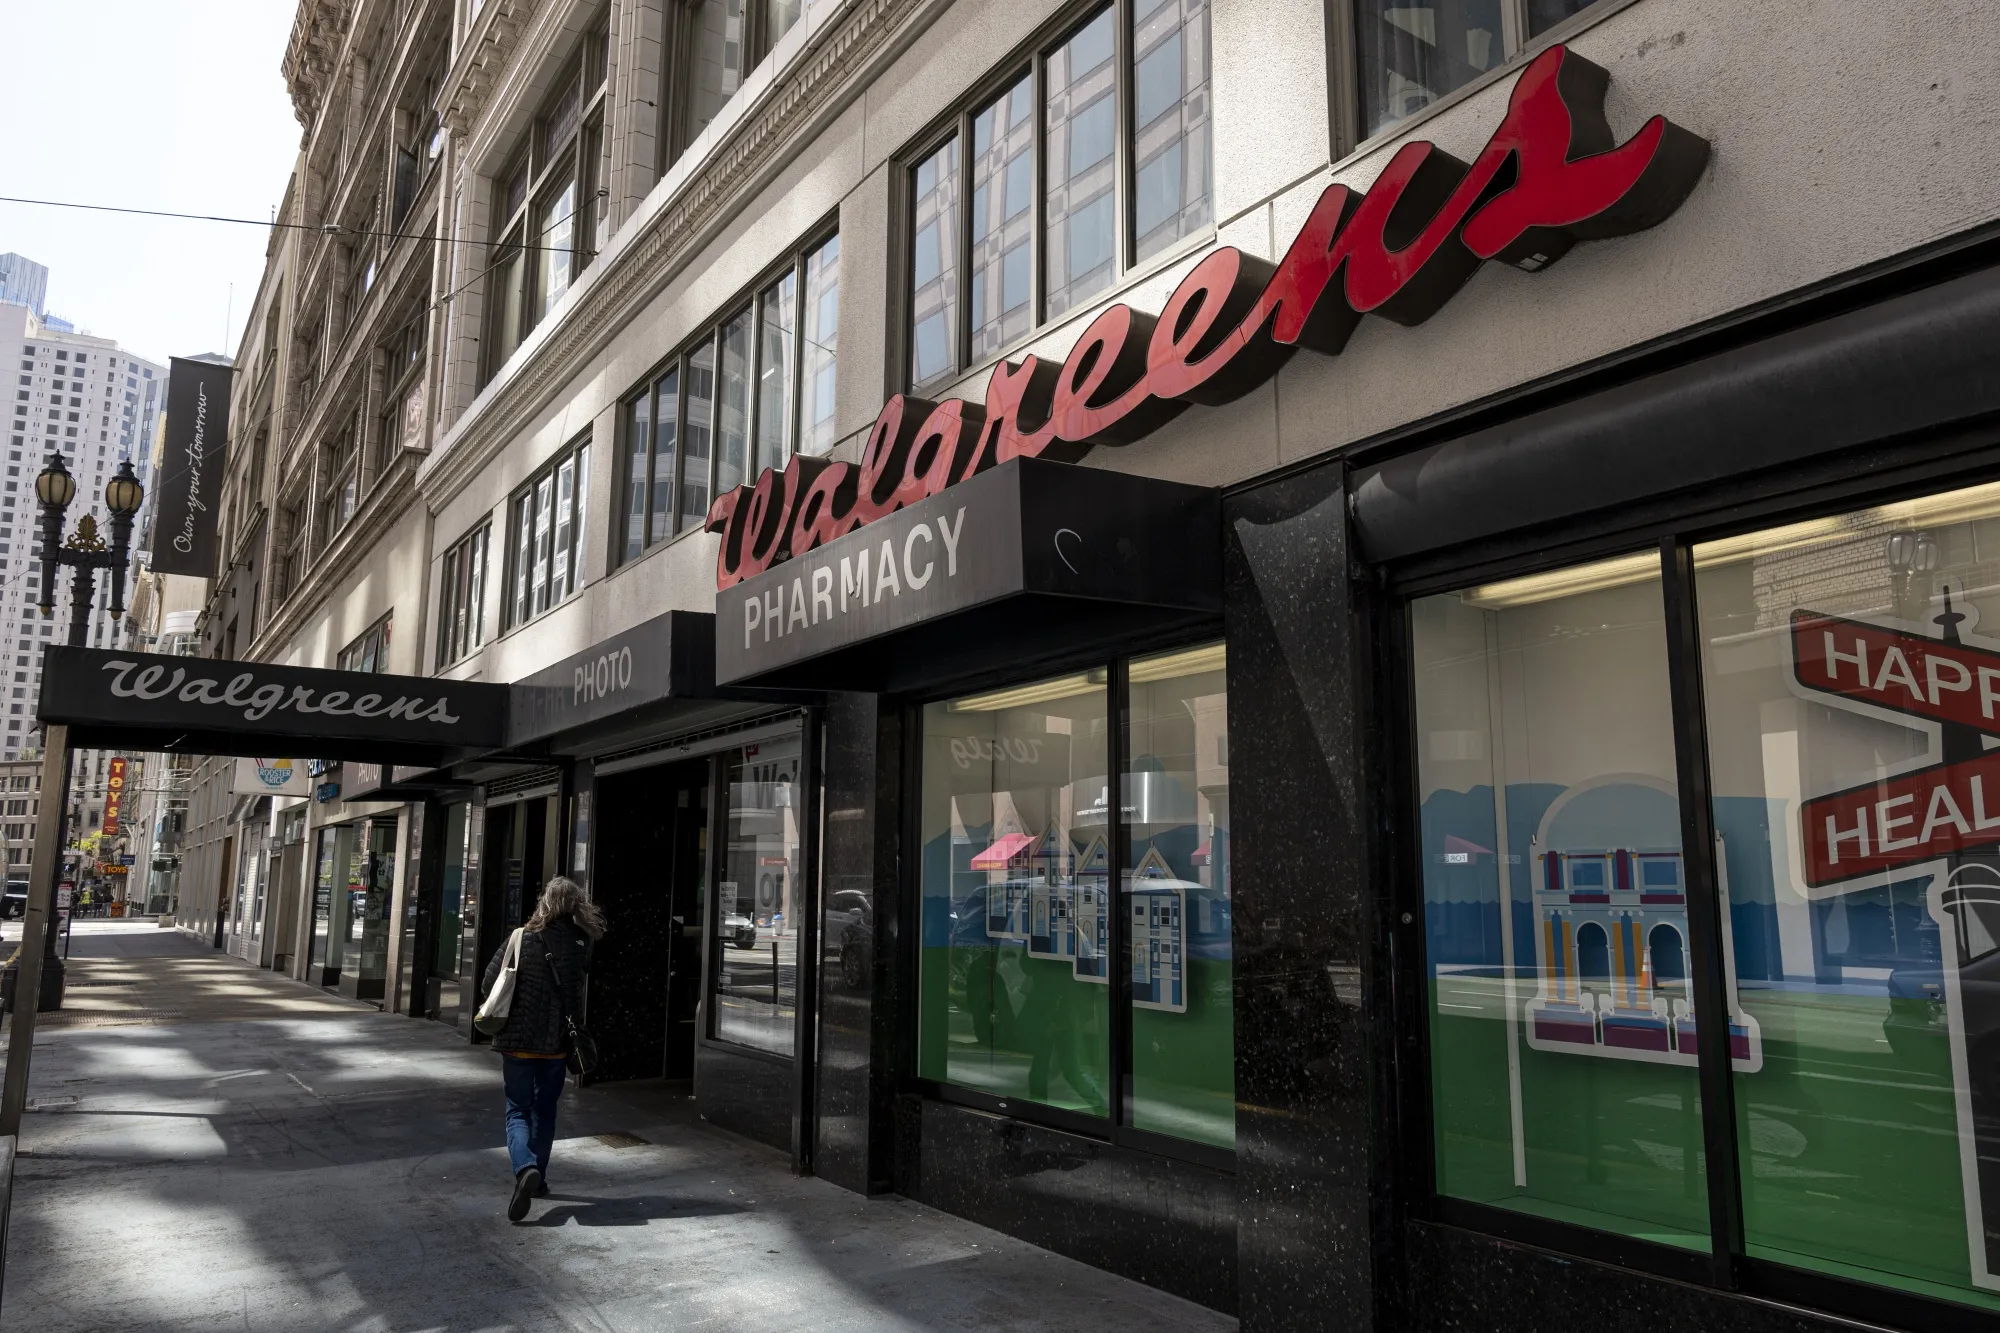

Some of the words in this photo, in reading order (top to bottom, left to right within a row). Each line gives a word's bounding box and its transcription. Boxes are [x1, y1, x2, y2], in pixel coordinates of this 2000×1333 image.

[704, 43, 1667, 592] Walgreens
[185, 382, 207, 467] tomorrow
[187, 467, 206, 511] your
[173, 513, 195, 552] Own
[744, 506, 967, 650] PHARMACY
[102, 660, 460, 723] Walgreens
[574, 646, 632, 706] PHOTO
[108, 762, 124, 818] TOYS
[259, 768, 291, 777] ROOSTER
[1824, 774, 2000, 865] HEAL
[107, 866, 127, 874] TOYS
